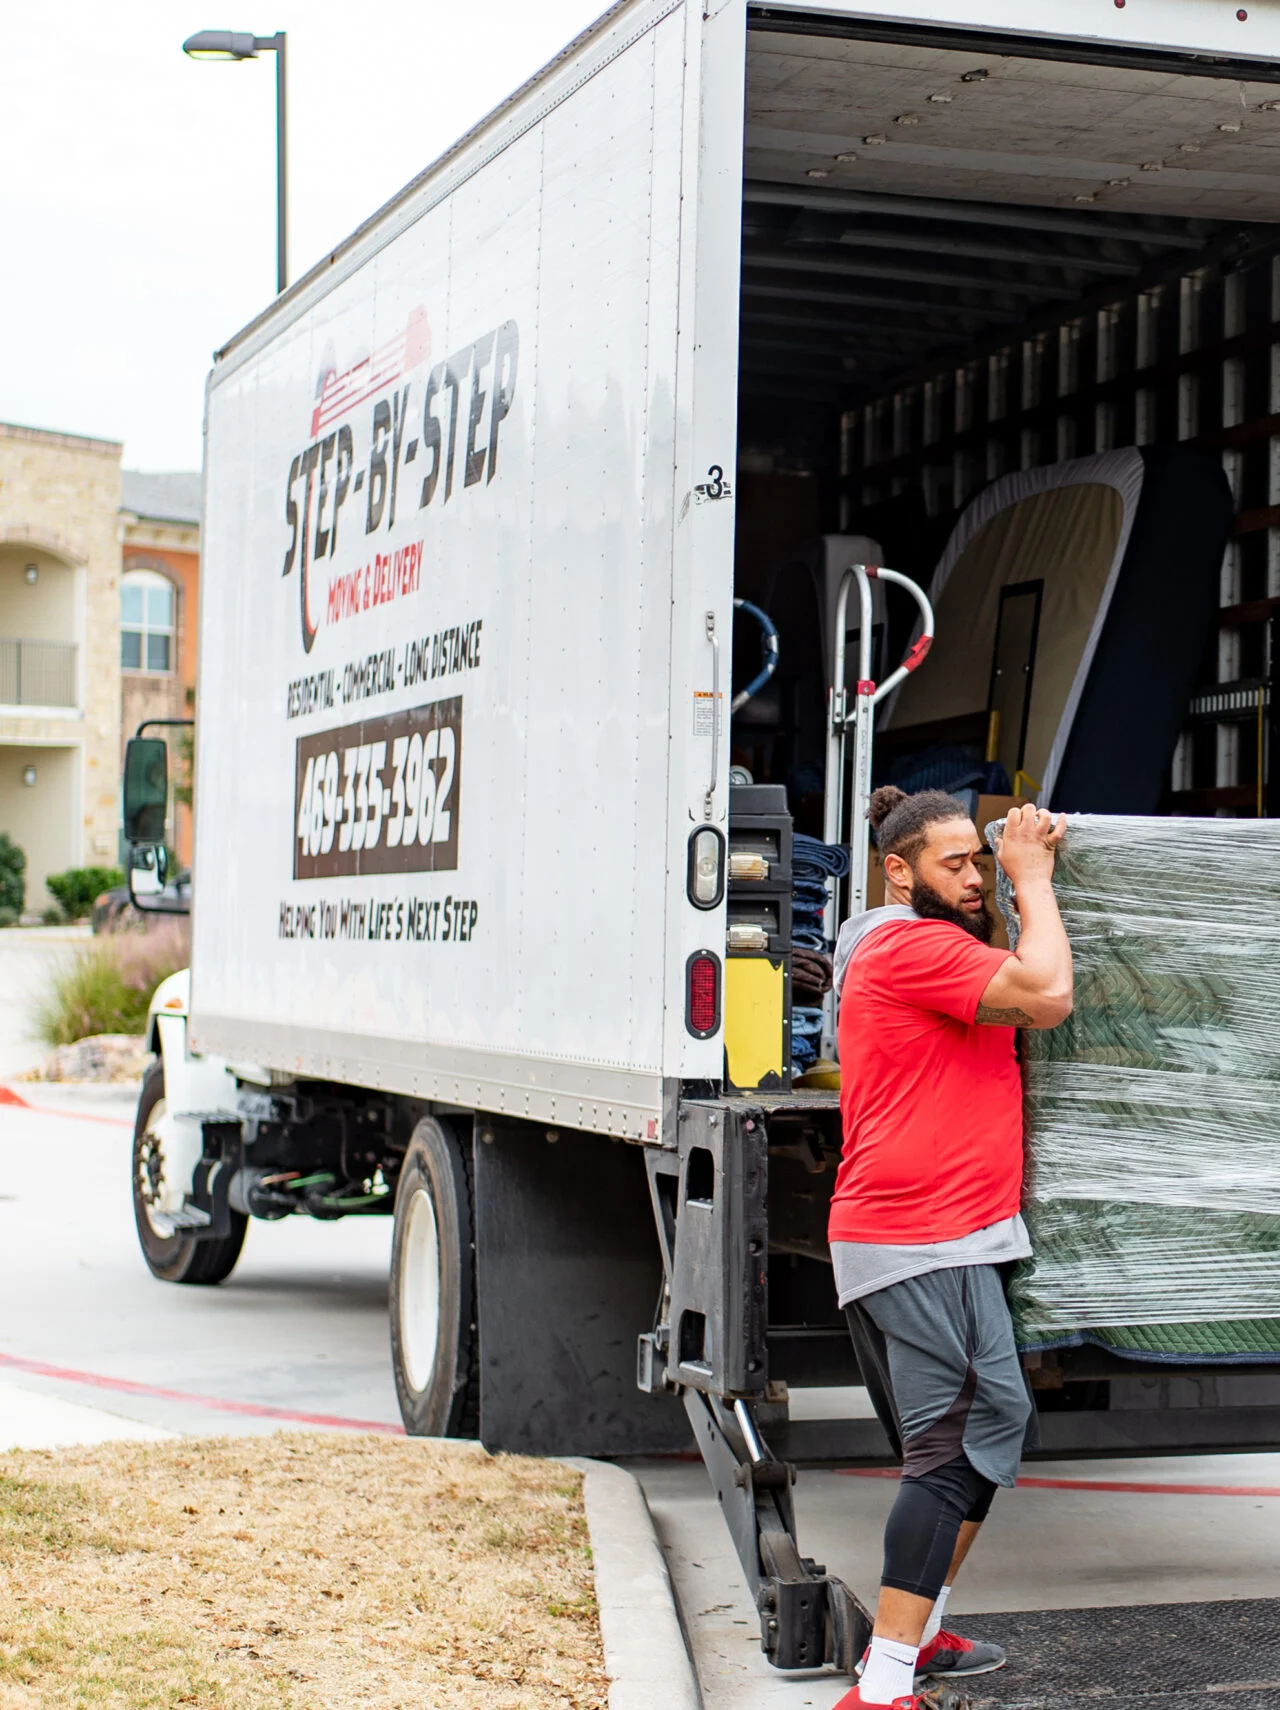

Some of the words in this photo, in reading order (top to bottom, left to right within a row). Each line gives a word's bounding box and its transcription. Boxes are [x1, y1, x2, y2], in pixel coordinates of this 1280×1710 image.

[282, 319, 519, 653] STEP-BY-STEP
[706, 465, 723, 499] 3
[327, 567, 361, 626] MOVING
[363, 564, 371, 611] &
[373, 539, 424, 606] DELIVERY
[287, 668, 335, 719] RESIDENTIAL
[343, 648, 396, 704] COMMERCIAL
[403, 637, 430, 687] LONG
[431, 619, 483, 679] DISTANCE
[298, 727, 455, 857] 469-335-3962
[279, 899, 316, 940] HELPING
[319, 898, 338, 940] YOU
[340, 898, 366, 940] WITH
[406, 896, 441, 941] NEXT
[442, 895, 479, 942] STEP
